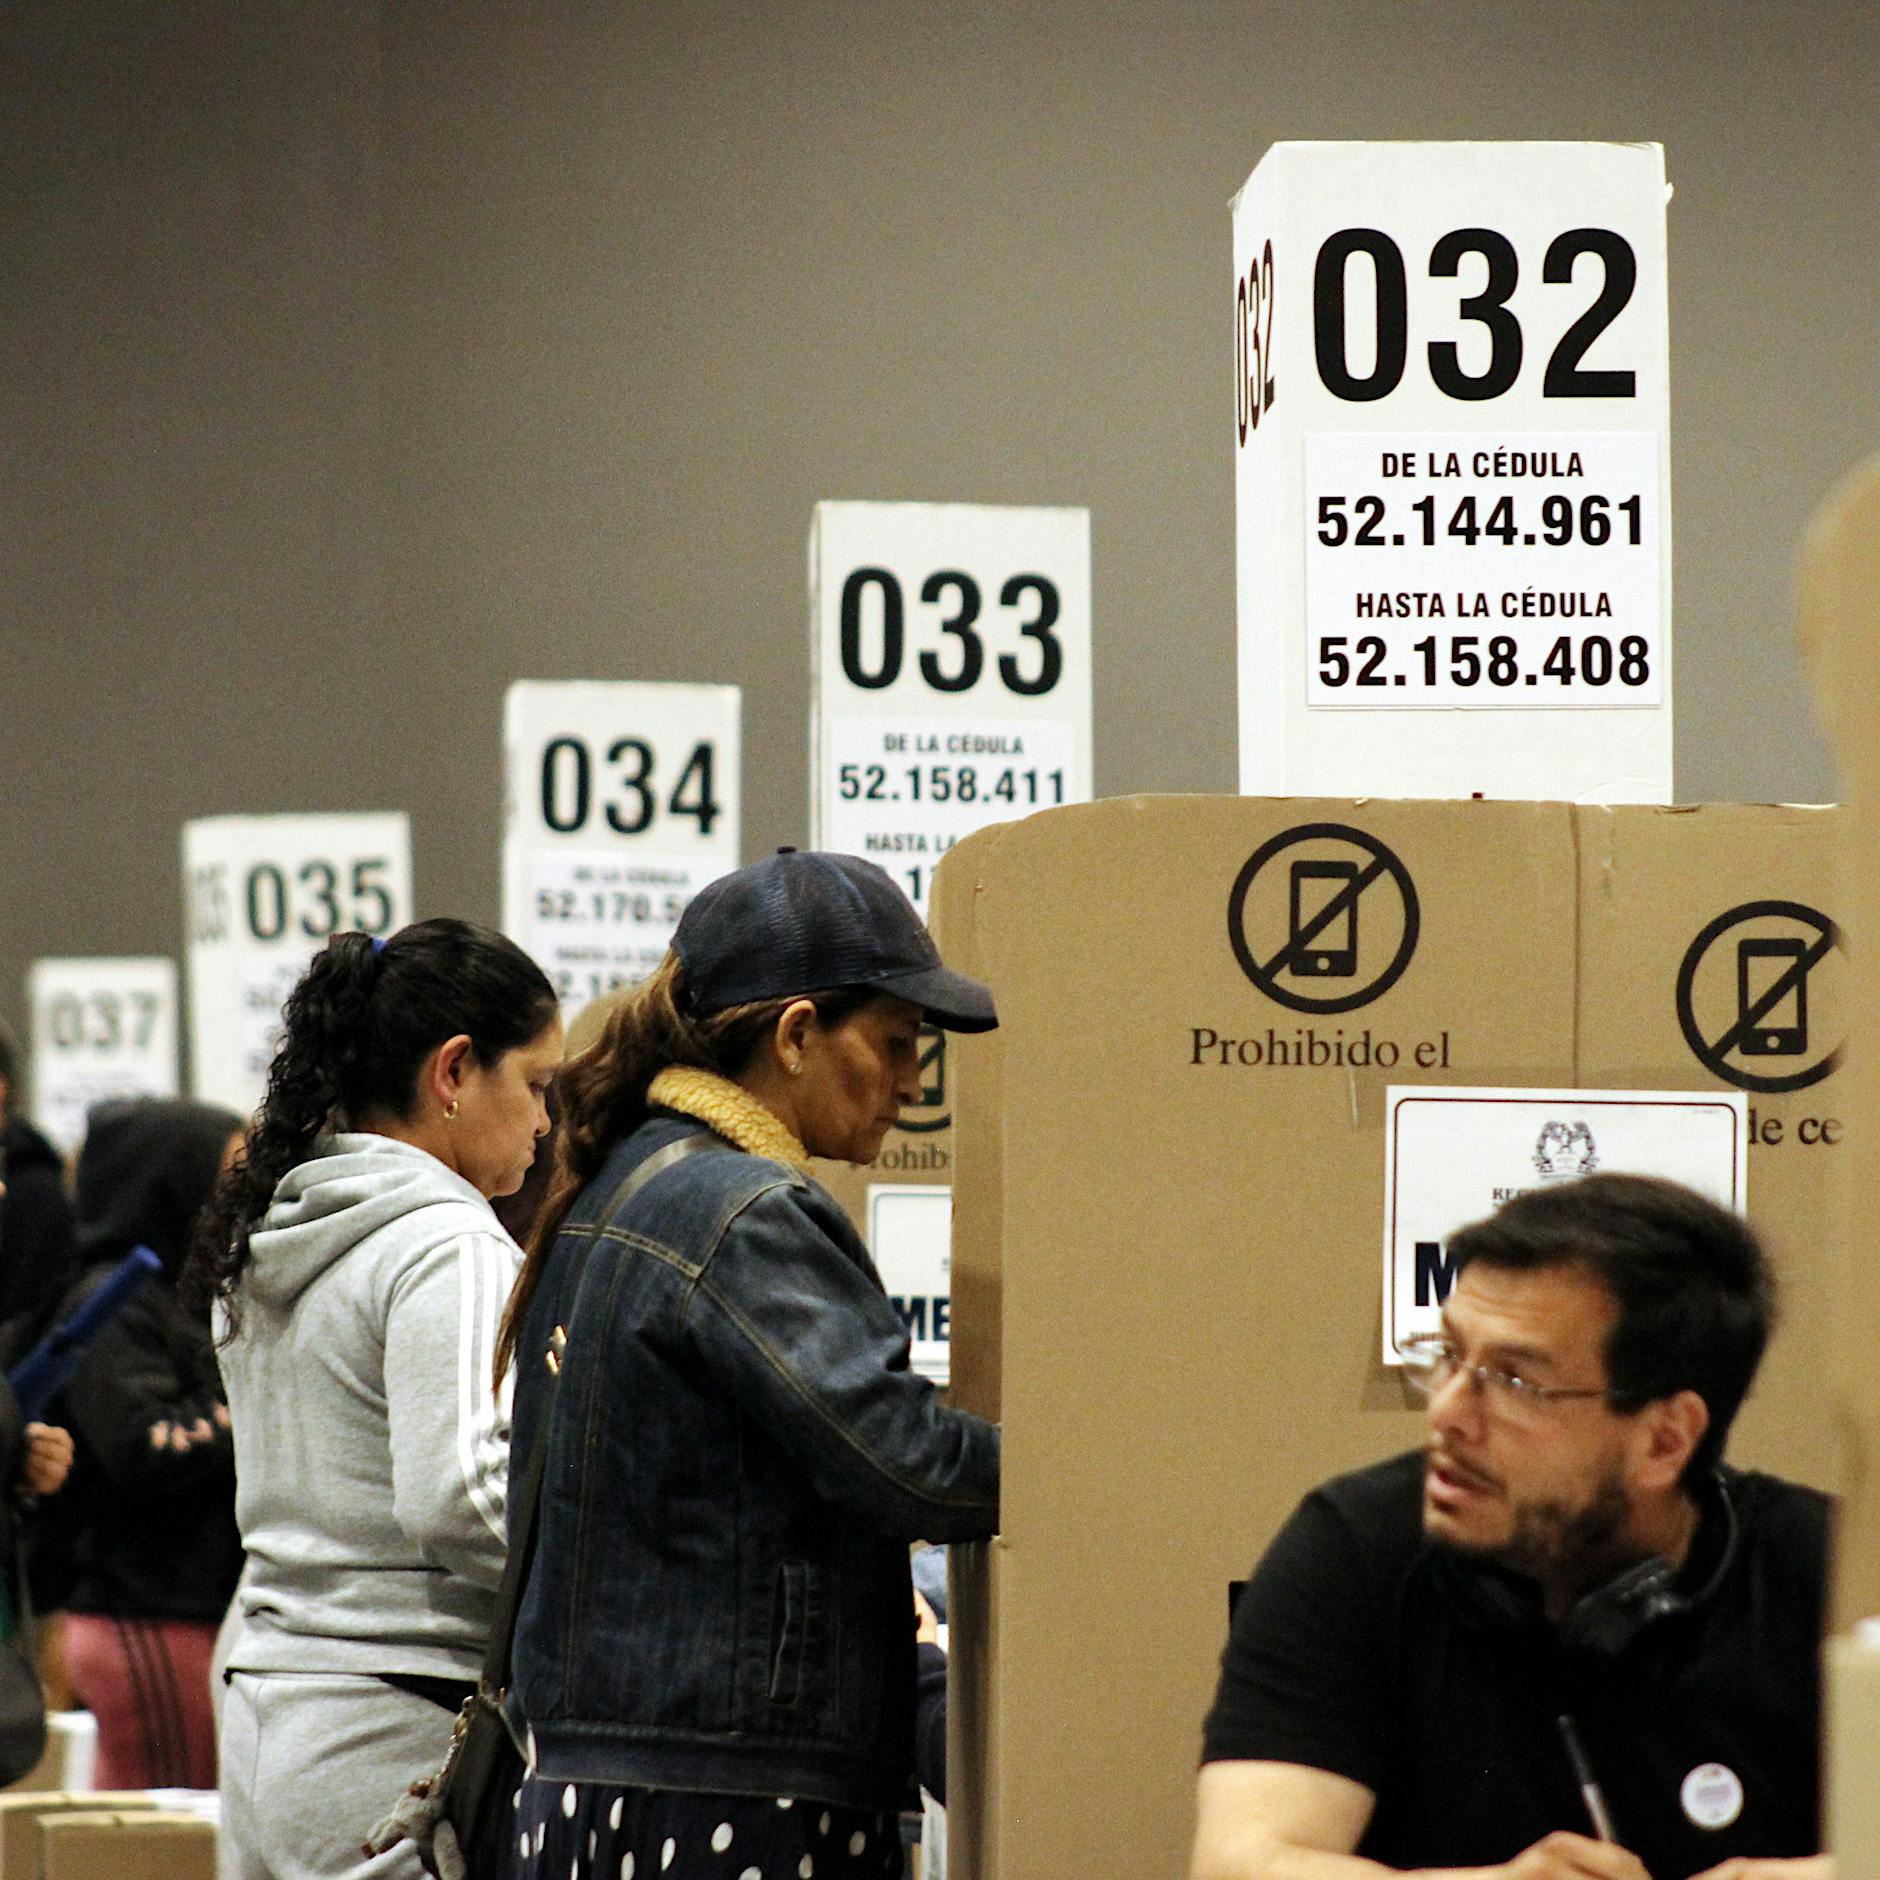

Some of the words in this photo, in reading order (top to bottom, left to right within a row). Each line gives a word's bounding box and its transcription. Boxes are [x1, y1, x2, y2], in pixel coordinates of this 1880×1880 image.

[1313, 227, 1638, 403] 032
[1237, 238, 1275, 448] 032
[1382, 452, 1416, 478] DE
[1428, 452, 1462, 478] LA
[1472, 445, 1584, 478] CÉDULA
[1317, 494, 1642, 547] 52.144.961
[1356, 592, 1446, 619] HASTA
[1457, 592, 1491, 619] LA
[1501, 585, 1613, 619] CÉDULA
[840, 566, 1063, 697] 033
[1319, 635, 1651, 688] 52.158.408
[884, 732, 908, 753] DE
[916, 733, 940, 753] LA
[540, 736, 721, 837] 034
[839, 764, 1065, 804] 52.158.411
[865, 832, 928, 853] HASTA
[244, 860, 394, 942] 035
[1189, 1028, 1400, 1069] Prohibido
[1414, 1030, 1451, 1069] el
